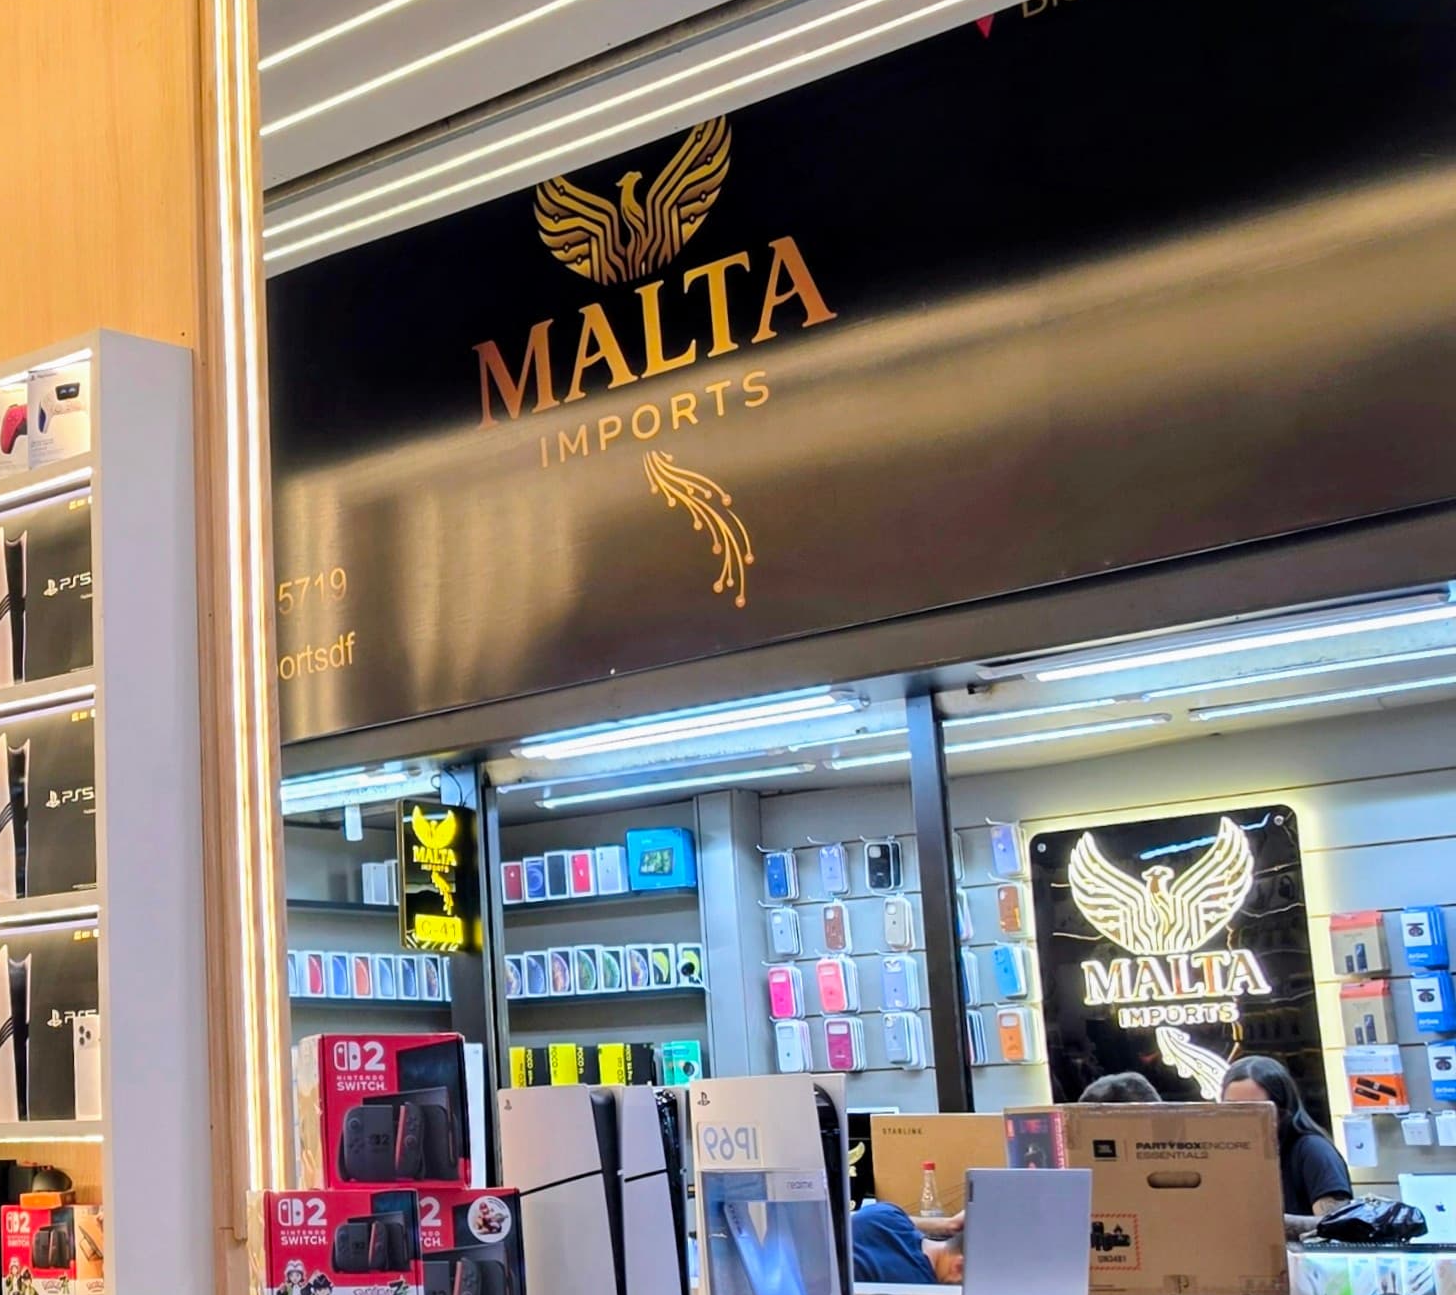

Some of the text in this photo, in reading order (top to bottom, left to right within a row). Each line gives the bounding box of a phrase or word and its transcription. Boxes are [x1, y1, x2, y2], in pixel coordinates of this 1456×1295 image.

[473, 235, 838, 428] MALTA
[541, 371, 771, 467] IMPORTS
[60, 572, 93, 591] PS5
[278, 567, 347, 615] 5719
[277, 630, 356, 680] ortsdf
[62, 786, 95, 804] PS5
[412, 845, 458, 866] MALTA
[1081, 950, 1273, 1005] MALTA
[1119, 1002, 1239, 1028] IMPORTS
[364, 1041, 386, 1071] 2
[576, 1047, 585, 1067] POCO
[336, 1080, 387, 1091] SWITCH
[882, 1127, 923, 1136] STARLINK
[19, 1211, 30, 1233] 2
[307, 1197, 328, 1227] 2
[421, 1196, 442, 1227] 2
[280, 1235, 328, 1246] SWITCH
